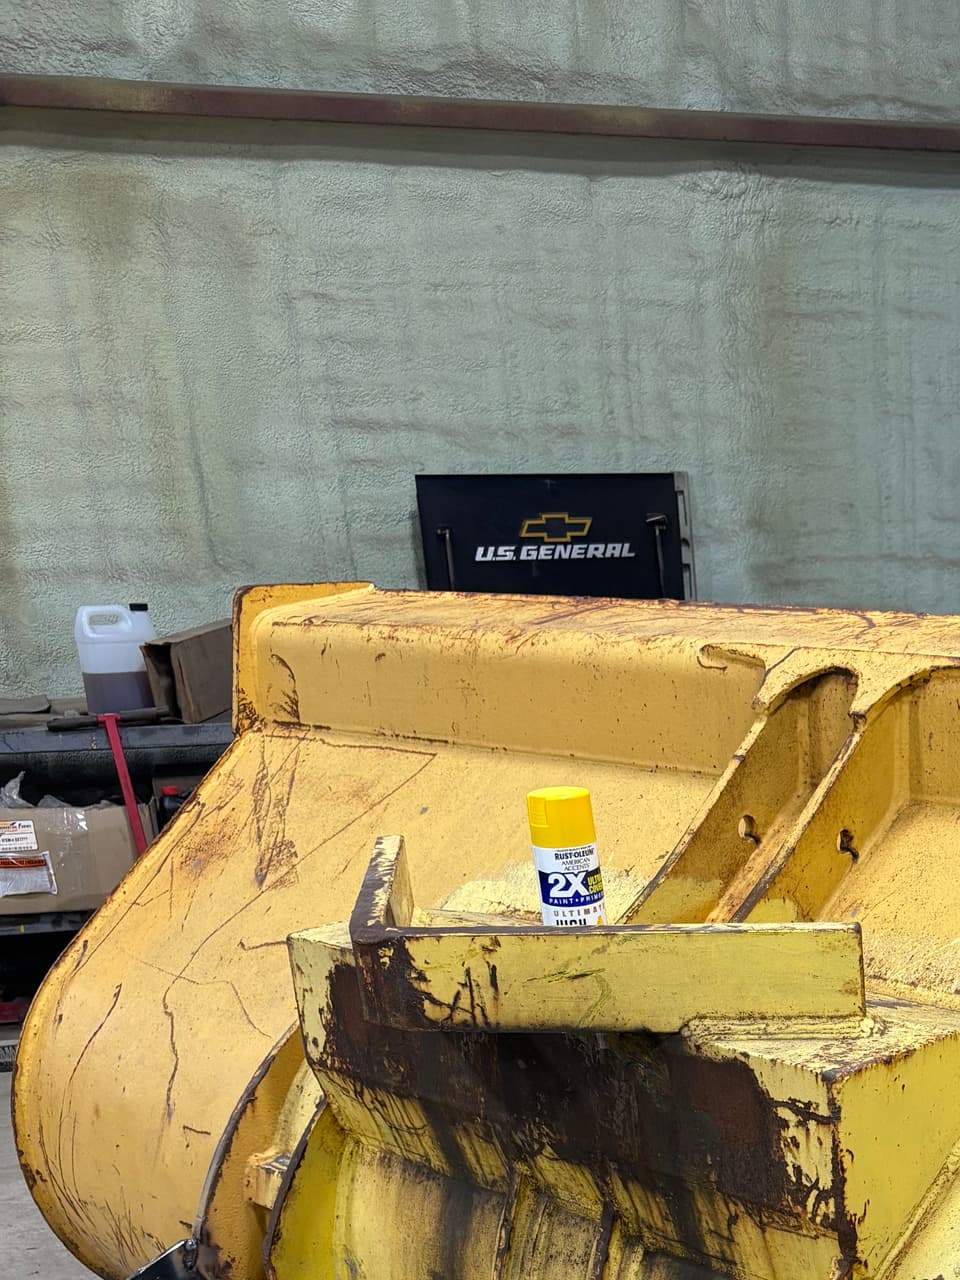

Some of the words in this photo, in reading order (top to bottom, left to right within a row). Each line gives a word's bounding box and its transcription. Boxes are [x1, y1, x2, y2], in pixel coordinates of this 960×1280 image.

[475, 546, 517, 561] U.S.
[519, 543, 636, 560] GENERAL
[554, 848, 594, 860] RUST-OLEUM
[548, 872, 590, 898] 2X
